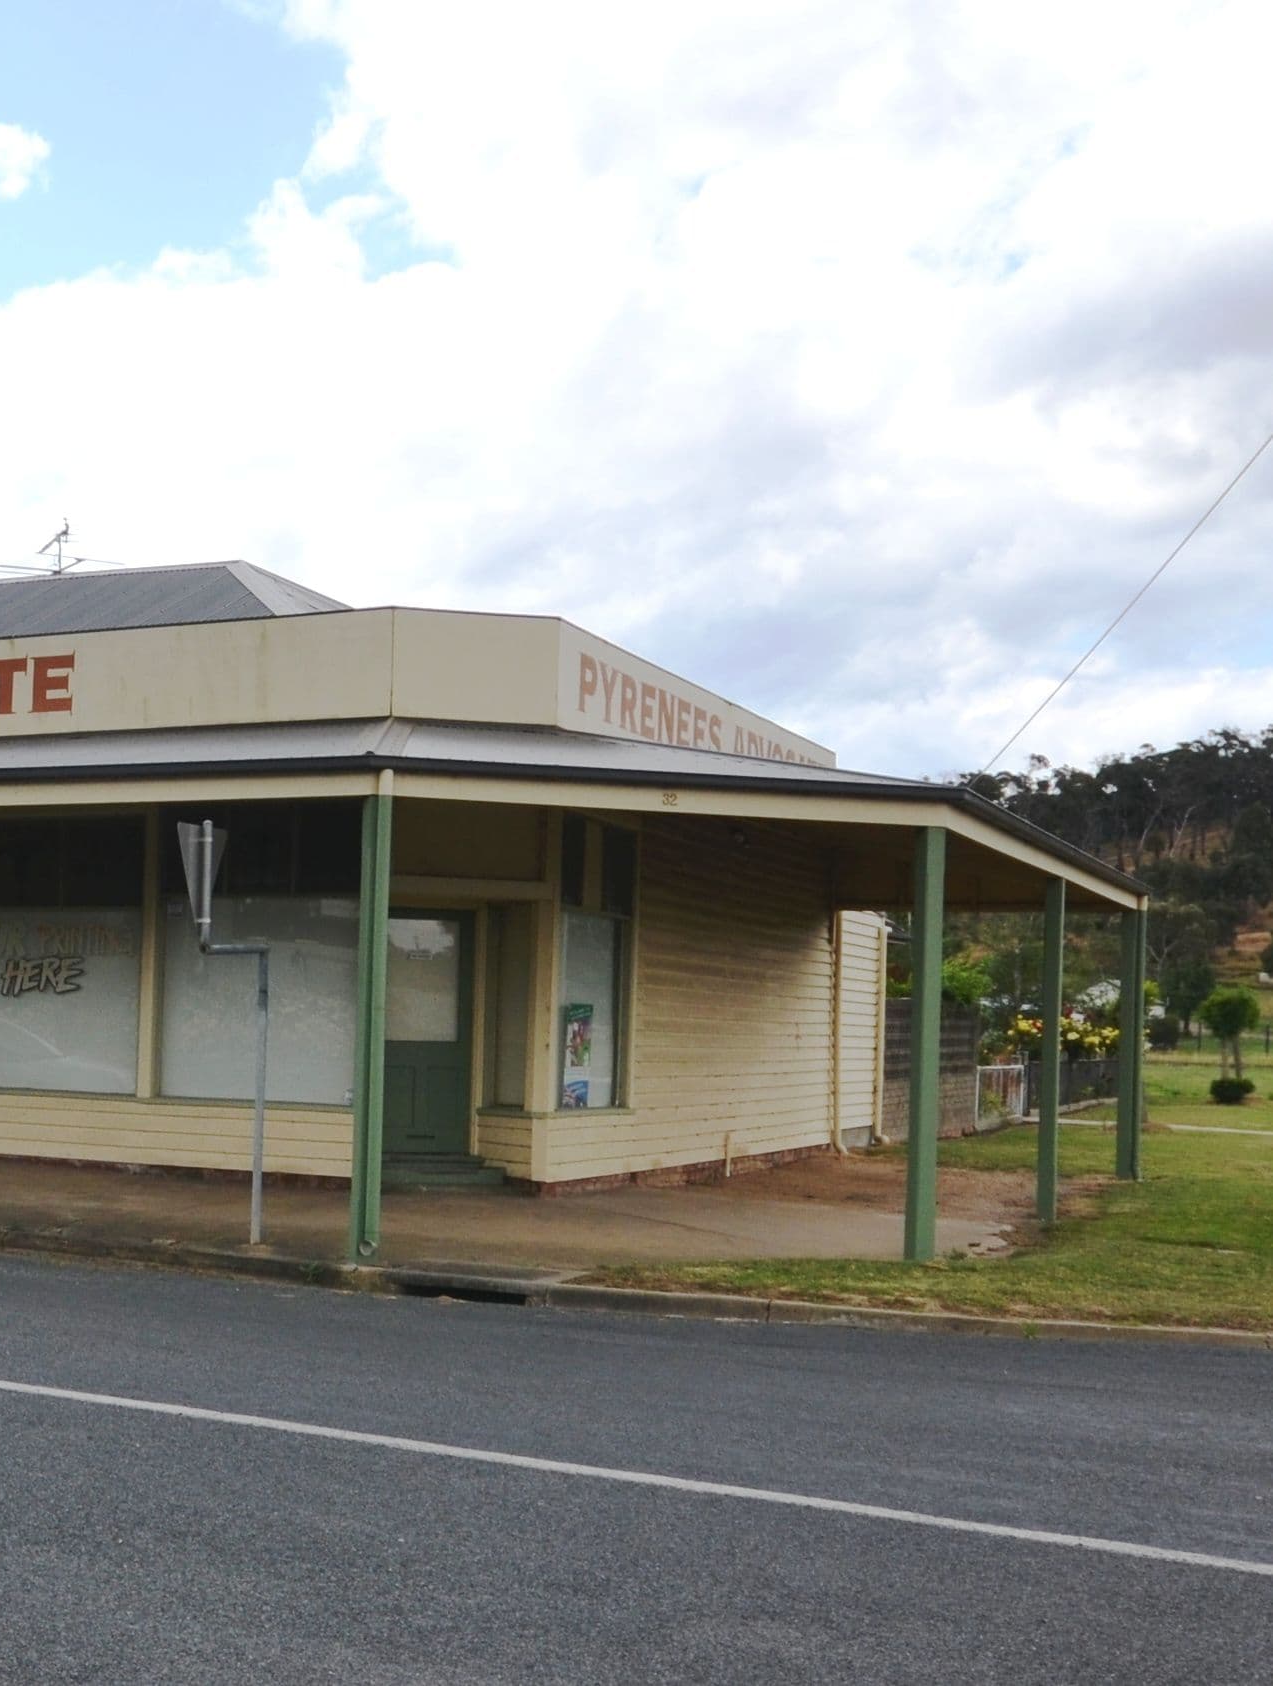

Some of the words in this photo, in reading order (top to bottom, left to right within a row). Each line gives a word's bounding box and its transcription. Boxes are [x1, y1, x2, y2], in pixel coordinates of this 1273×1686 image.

[577, 652, 722, 751] PYRENEES
[662, 792, 678, 807] 32
[0, 955, 86, 997] HERE
